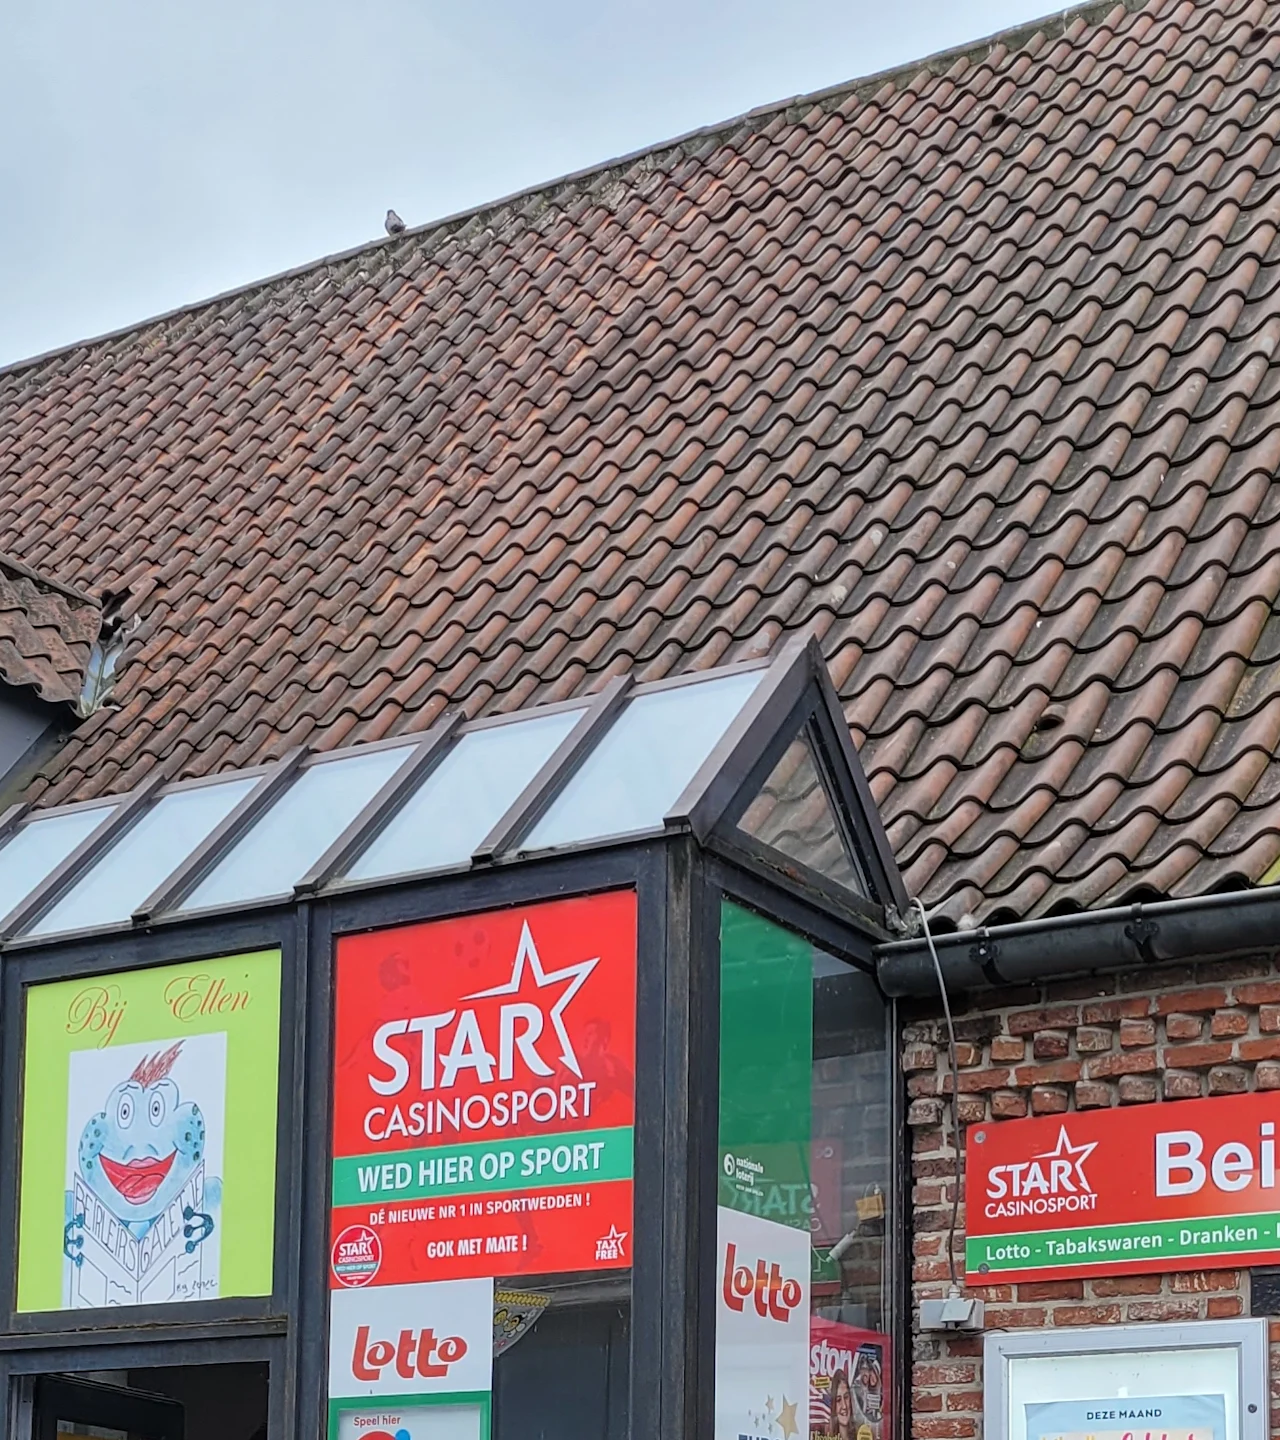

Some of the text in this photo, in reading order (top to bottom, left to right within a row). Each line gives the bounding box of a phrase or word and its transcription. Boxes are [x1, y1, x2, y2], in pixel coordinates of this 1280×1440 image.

[66, 973, 254, 1049] Bij Ellen
[368, 1003, 556, 1096] STAR
[363, 1081, 597, 1140] CASINOSPORT
[358, 1142, 605, 1193] WED HIER OP SPORT
[736, 1156, 764, 1174] nationale
[986, 1161, 1091, 1199] STAR
[370, 1193, 582, 1225] DÉ NIEUWE NR IN SPORTWEDDEN
[985, 1194, 1098, 1219] CASINOSPORT
[339, 1243, 368, 1256] STAR
[427, 1235, 519, 1258] GOK MET MATE
[595, 1250, 618, 1260] FREE
[986, 1242, 1031, 1262] Lotto
[1045, 1232, 1163, 1257] Tabakswaren
[1179, 1225, 1258, 1247] Dranken
[351, 1325, 468, 1381] lotto
[354, 1415, 400, 1428] Speel hier
[1086, 1408, 1162, 1421] DEZE MAAND
